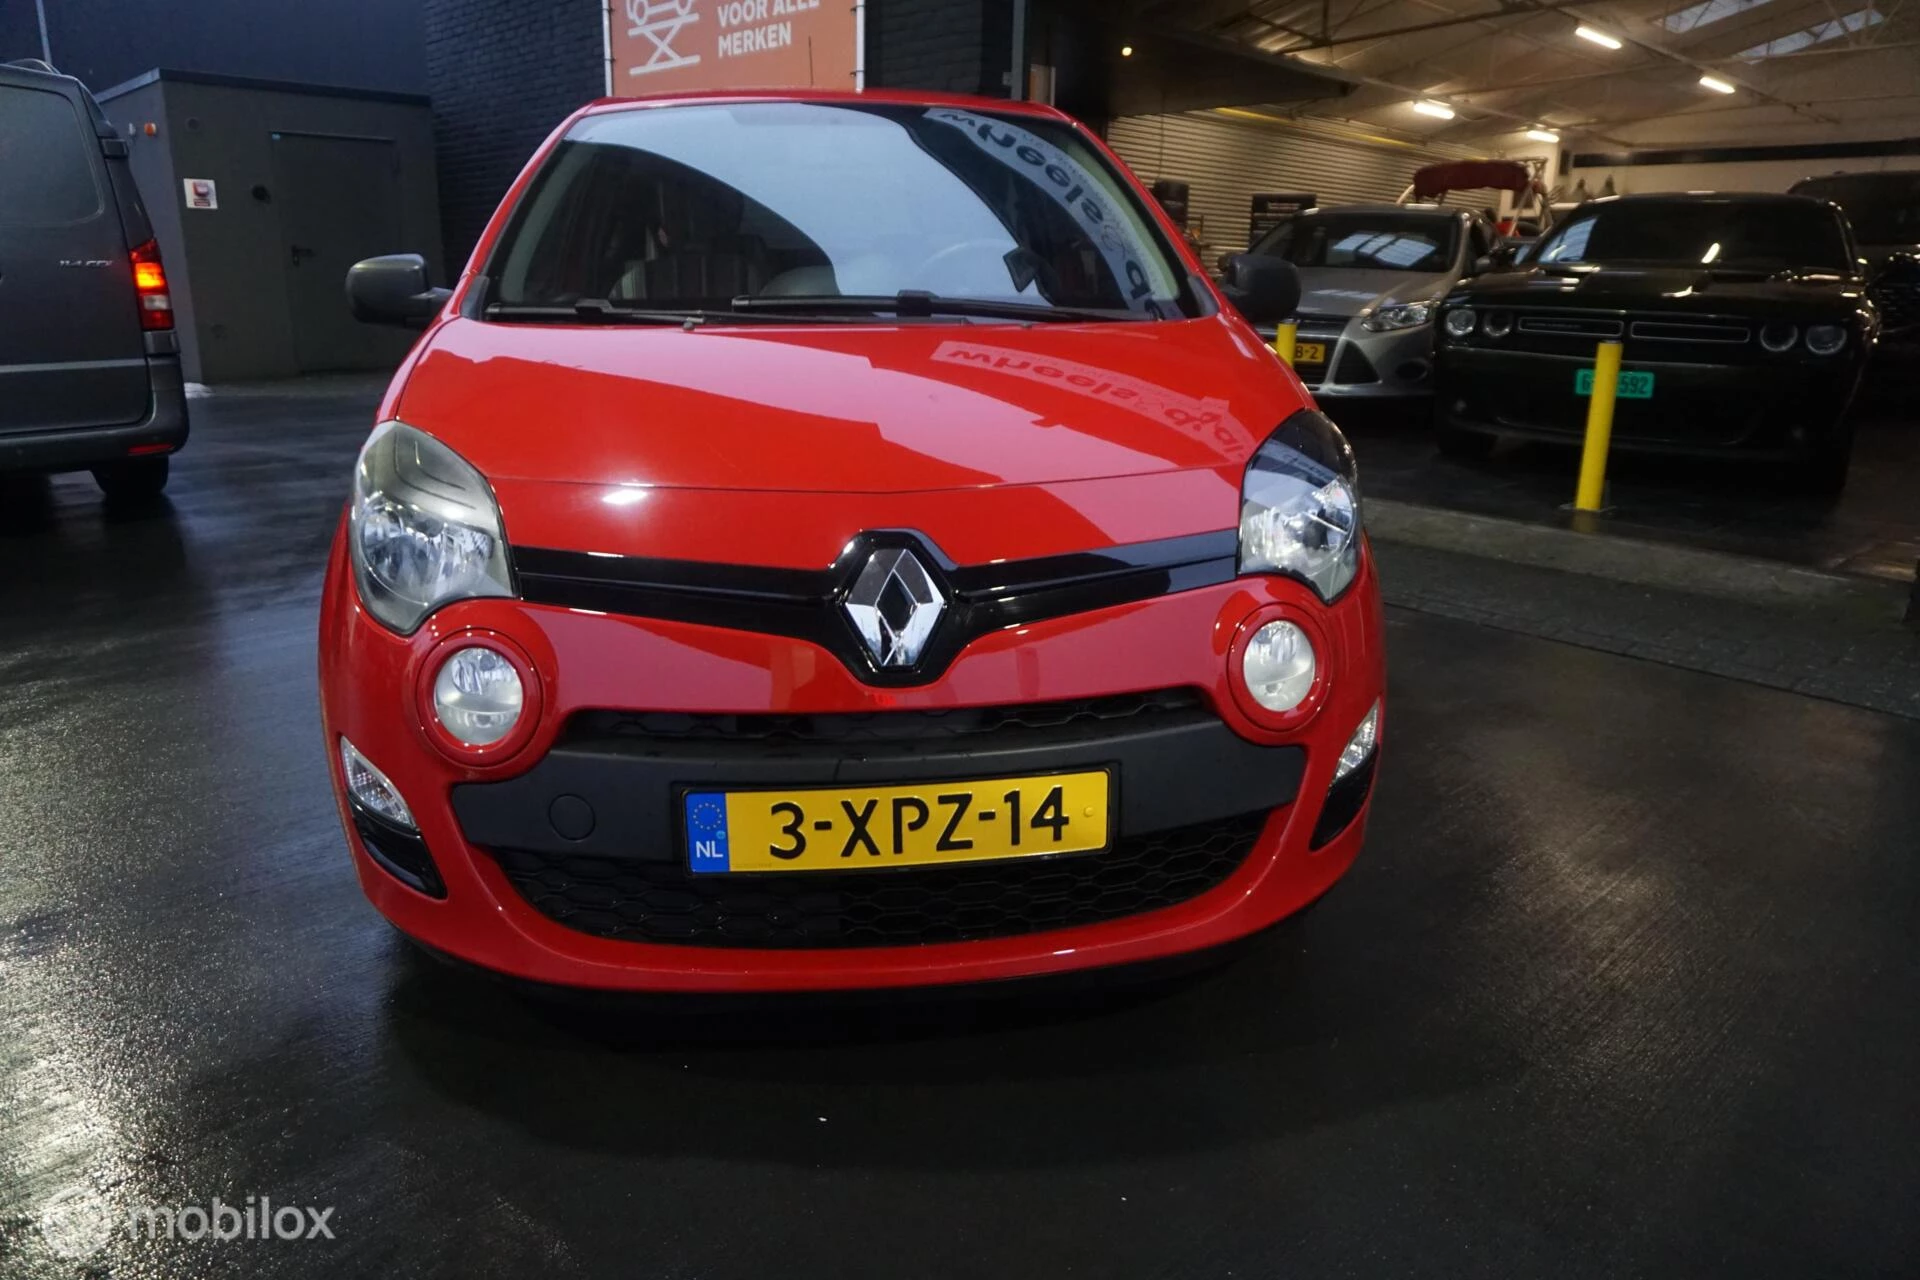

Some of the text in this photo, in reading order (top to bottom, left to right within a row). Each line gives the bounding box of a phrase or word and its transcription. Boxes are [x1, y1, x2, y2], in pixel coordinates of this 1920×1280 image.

[717, 0, 767, 28] VOOR
[718, 20, 792, 58] MERKEN
[769, 786, 1070, 861] 3-XPZ-14
[695, 840, 724, 858] NL
